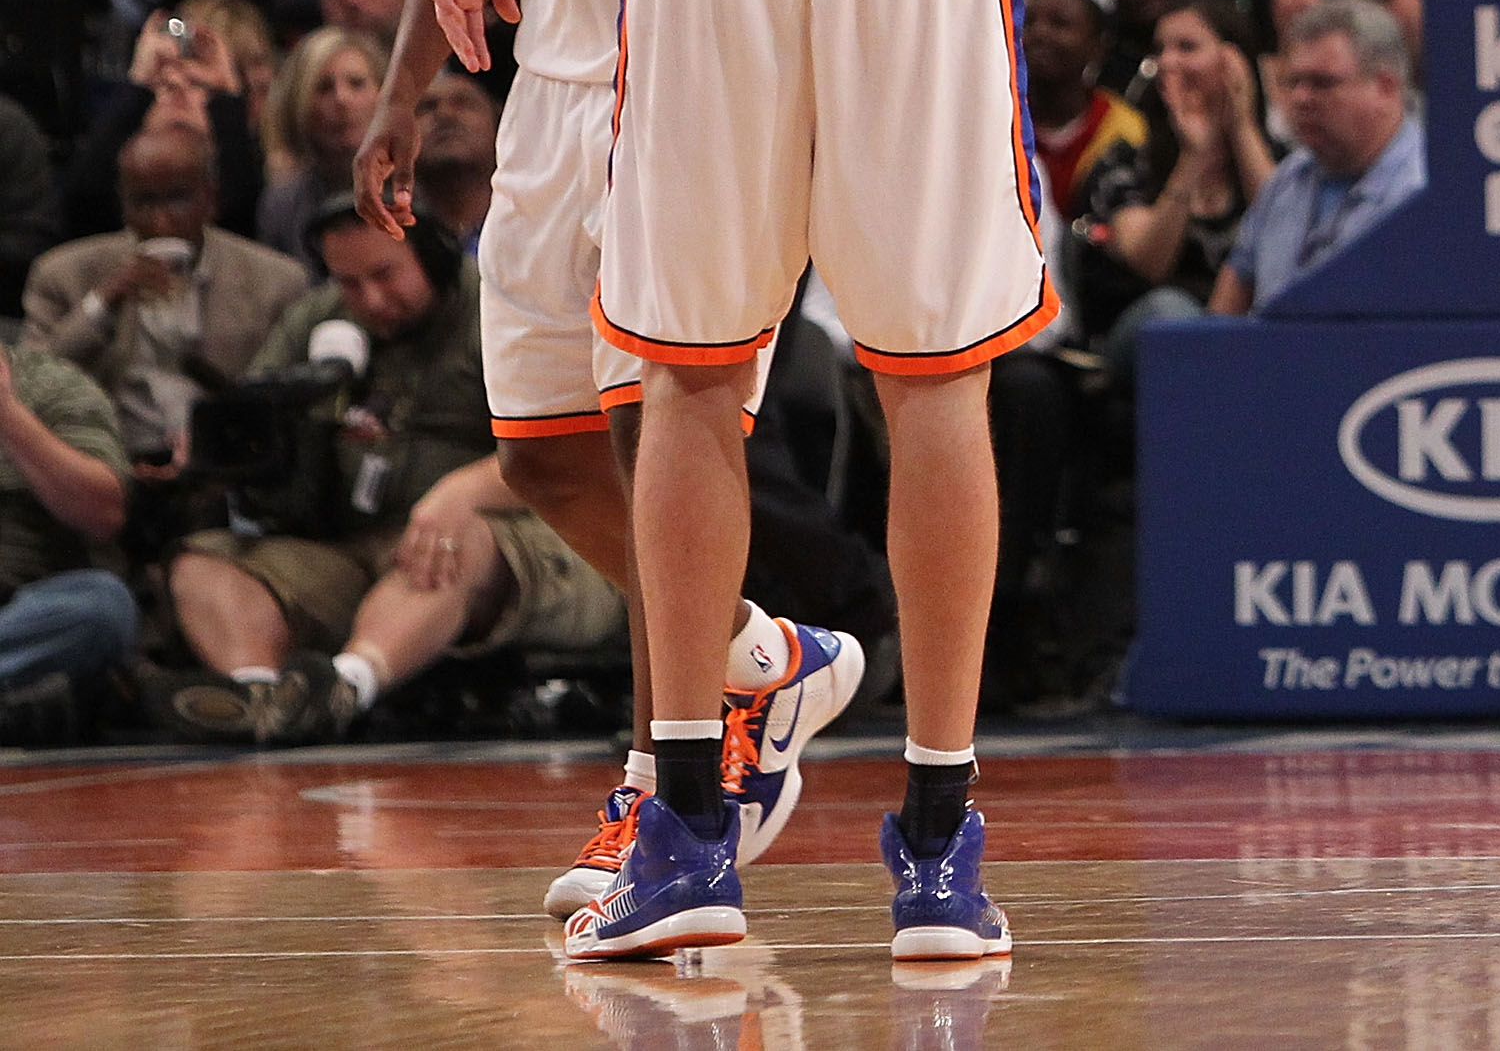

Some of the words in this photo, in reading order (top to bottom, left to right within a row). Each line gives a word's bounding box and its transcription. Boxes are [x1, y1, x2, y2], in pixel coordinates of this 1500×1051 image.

[1233, 559, 1378, 626] KIA
[1257, 647, 1341, 691] The
[1343, 647, 1482, 691] Power
